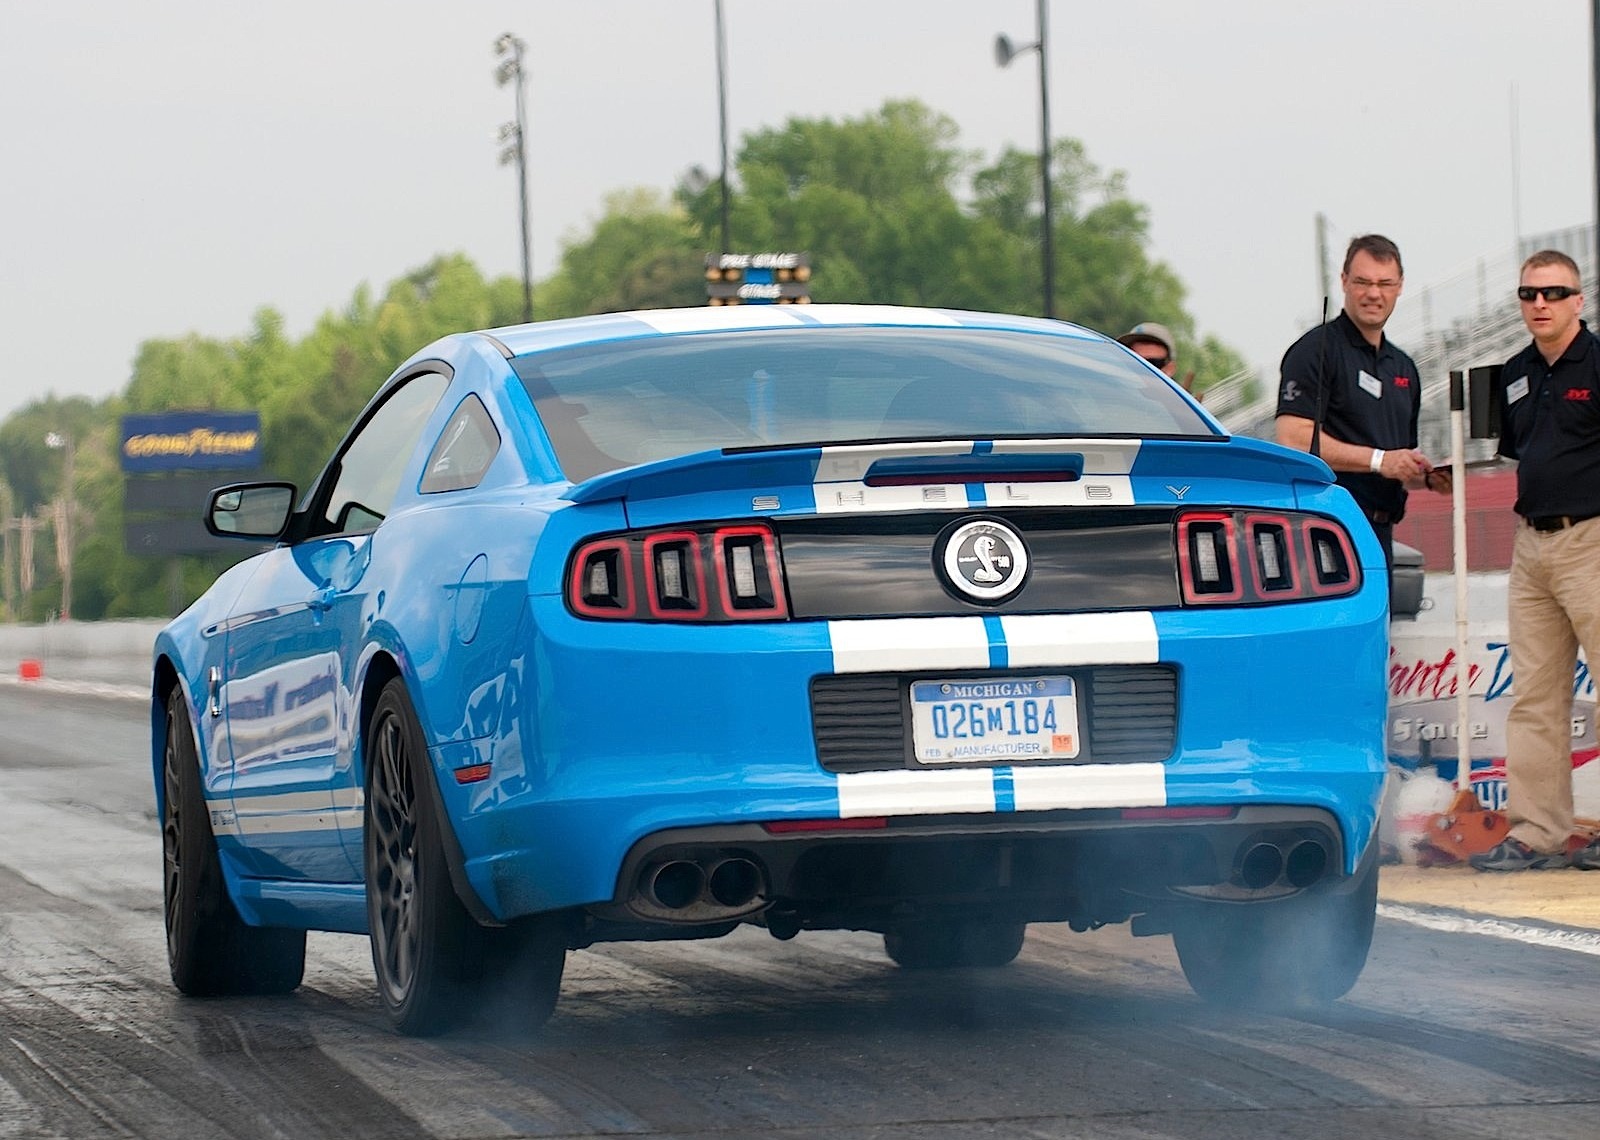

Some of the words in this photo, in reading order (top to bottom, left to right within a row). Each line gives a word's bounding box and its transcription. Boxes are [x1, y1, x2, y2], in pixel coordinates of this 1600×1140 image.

[752, 485, 1191, 510] SHELBY
[954, 684, 1032, 697] MICHIGAN
[932, 700, 1057, 738] 026M184
[953, 743, 1040, 756] MANUFACTURER
